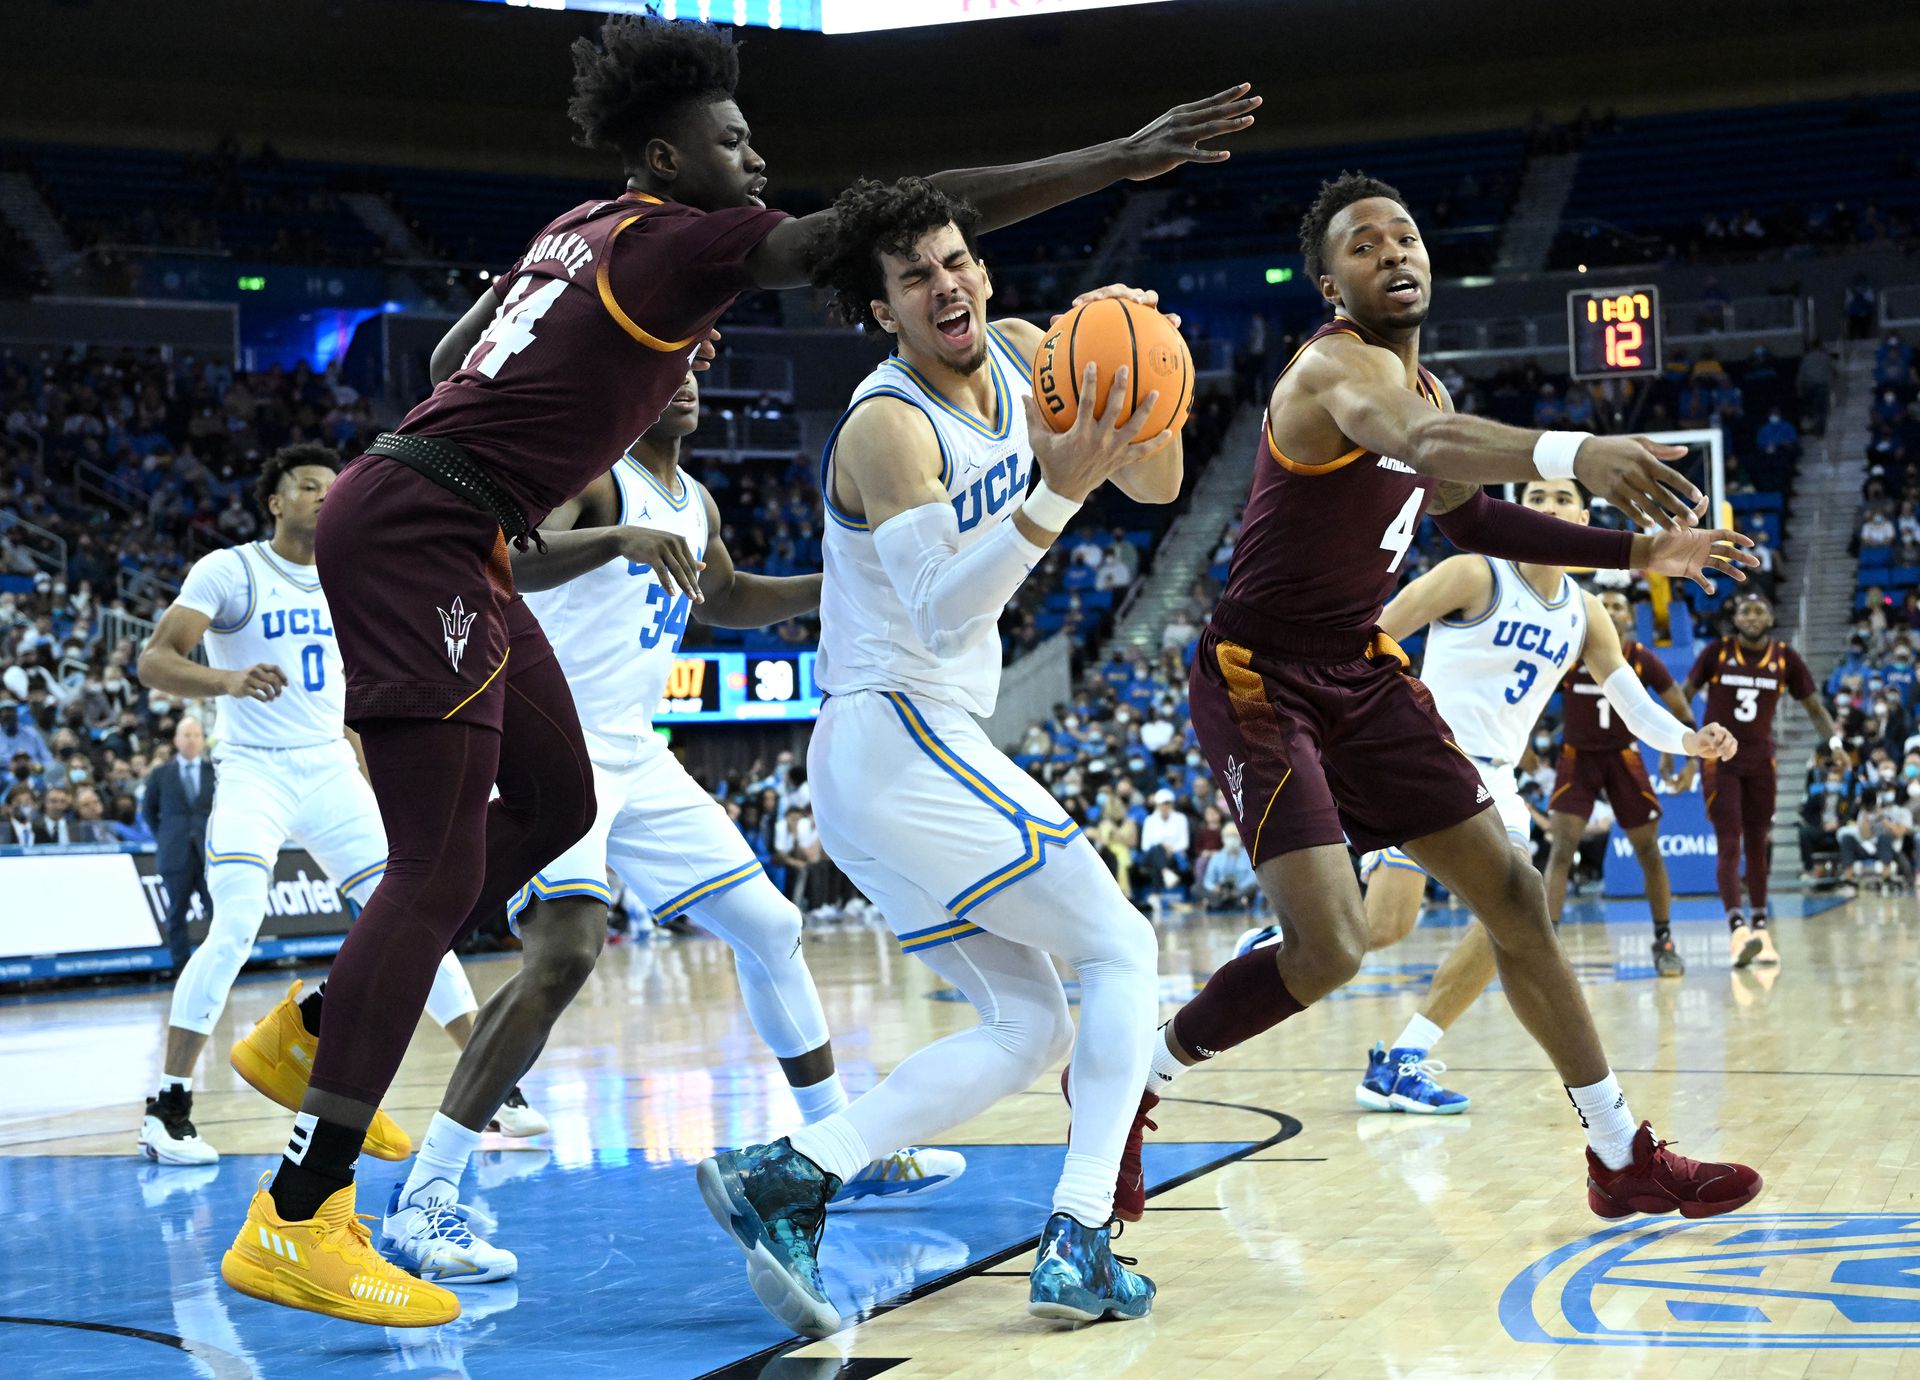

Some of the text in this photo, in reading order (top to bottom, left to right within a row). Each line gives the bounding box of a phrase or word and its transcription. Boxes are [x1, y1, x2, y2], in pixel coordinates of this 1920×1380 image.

[1587, 294, 1650, 323] 11:07
[1605, 322, 1642, 368] 12
[1039, 330, 1066, 415] UCLA
[951, 453, 1031, 534] UCL
[1380, 487, 1426, 573] 4
[639, 583, 691, 655] 34
[302, 644, 325, 692] 0
[1492, 620, 1569, 669] UCLA
[1504, 659, 1539, 705] 3
[1734, 687, 1760, 722] 3
[1596, 697, 1611, 729] 1
